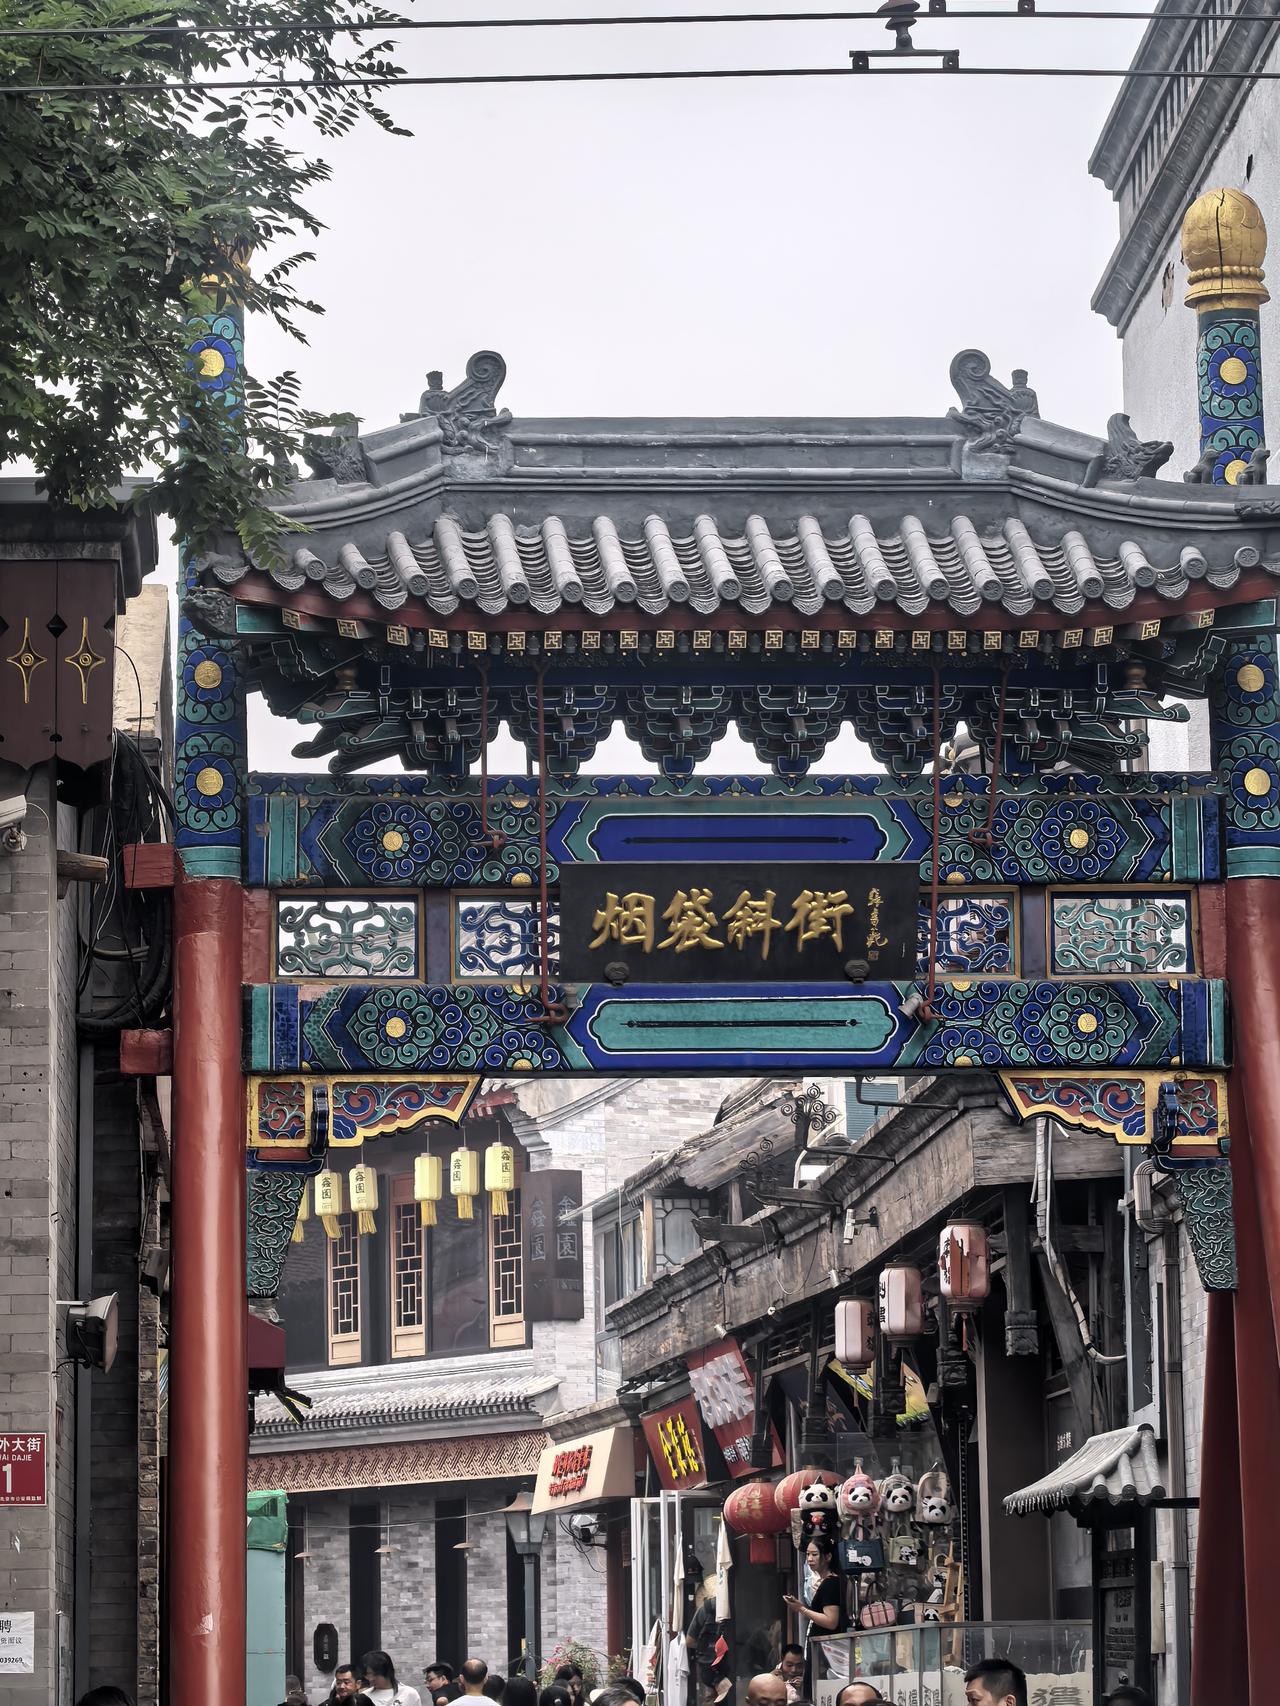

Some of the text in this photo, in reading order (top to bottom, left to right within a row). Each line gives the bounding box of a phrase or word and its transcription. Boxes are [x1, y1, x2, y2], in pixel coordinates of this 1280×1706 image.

[588, 887, 854, 960] 烟袋斜街
[0, 1437, 42, 1453] 外大街
[2, 1463, 12, 1494] 1
